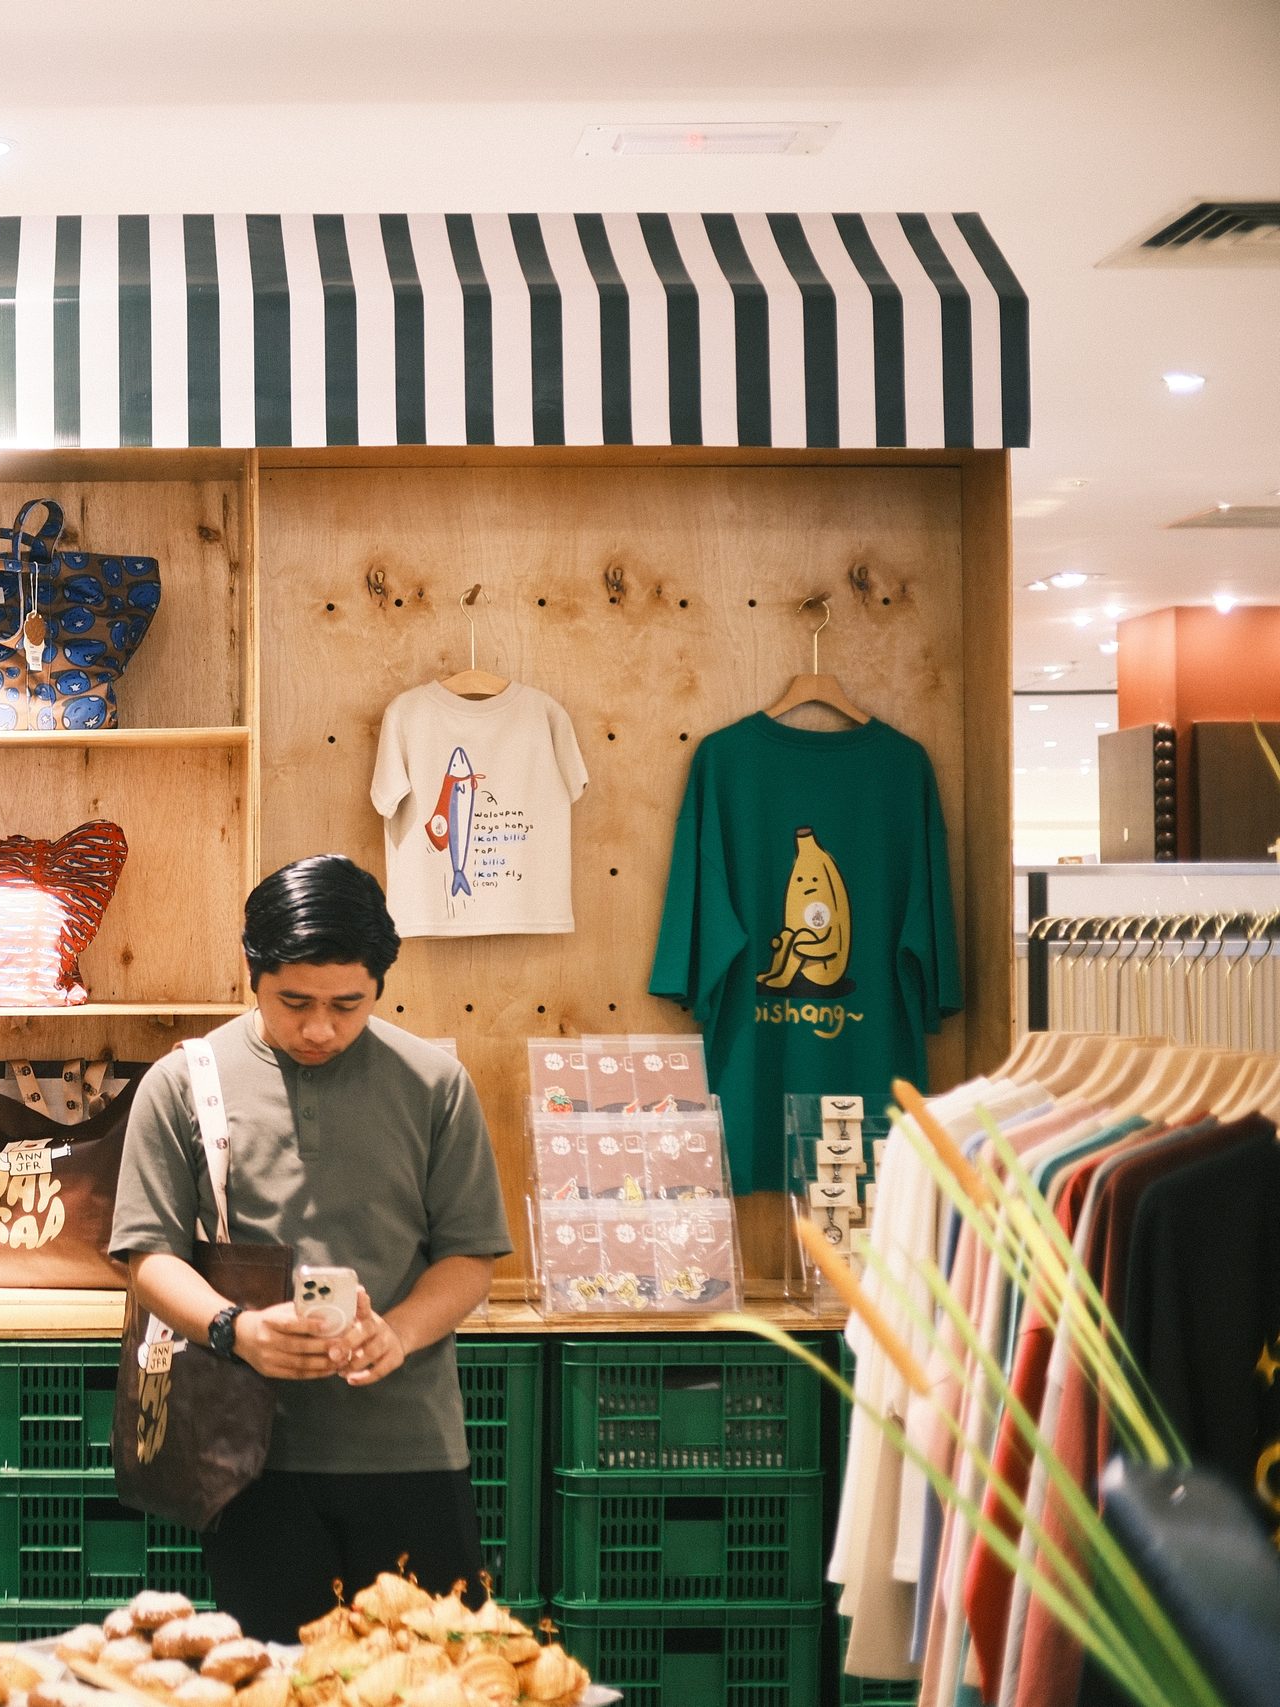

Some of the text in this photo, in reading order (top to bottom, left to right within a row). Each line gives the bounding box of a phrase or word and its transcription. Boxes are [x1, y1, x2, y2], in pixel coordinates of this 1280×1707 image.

[474, 810, 524, 818] walaupun
[474, 822, 534, 834] saya hanya
[505, 870, 523, 881] fly
[15, 1151, 43, 1162] ANN
[152, 1344, 170, 1357] ANN
